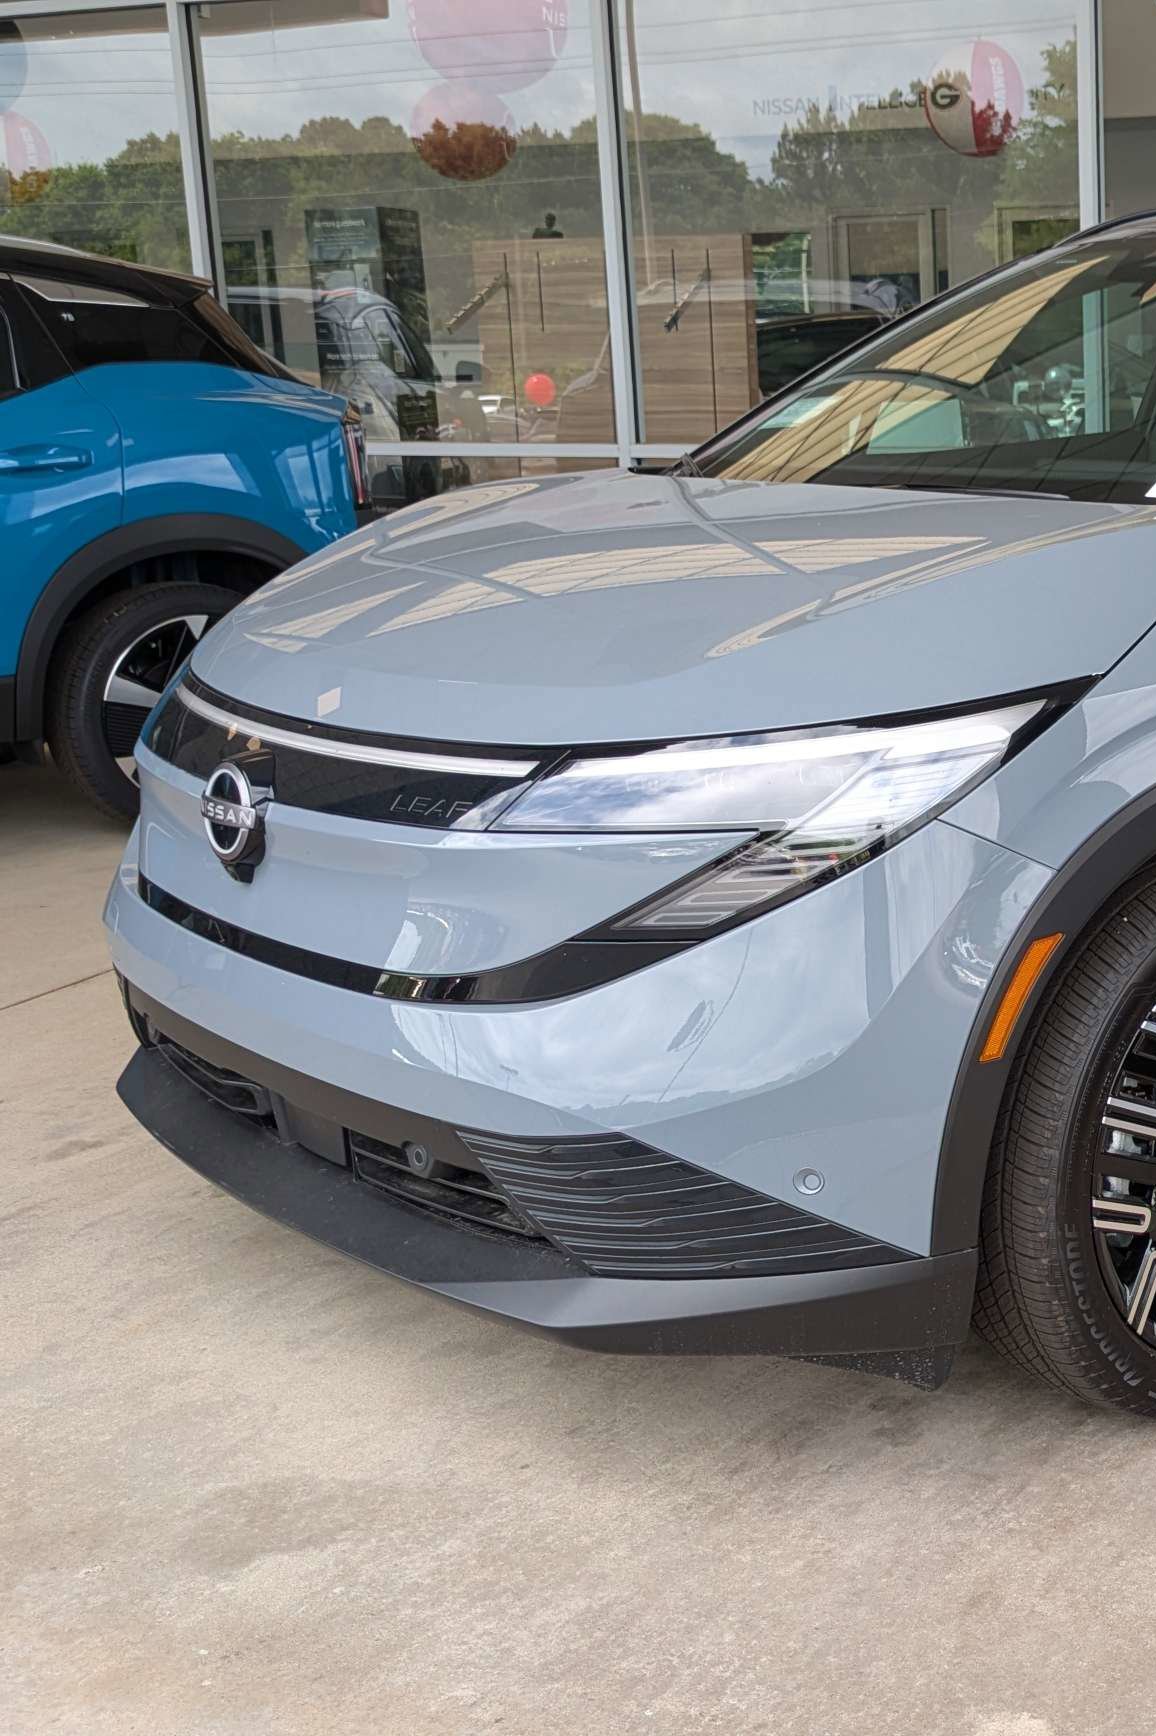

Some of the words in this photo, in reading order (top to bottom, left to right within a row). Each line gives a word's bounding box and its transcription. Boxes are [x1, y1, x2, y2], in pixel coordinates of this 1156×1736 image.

[752, 97, 820, 115] NISSAN
[201, 799, 255, 827] NISSAN
[390, 794, 473, 818] LEAF
